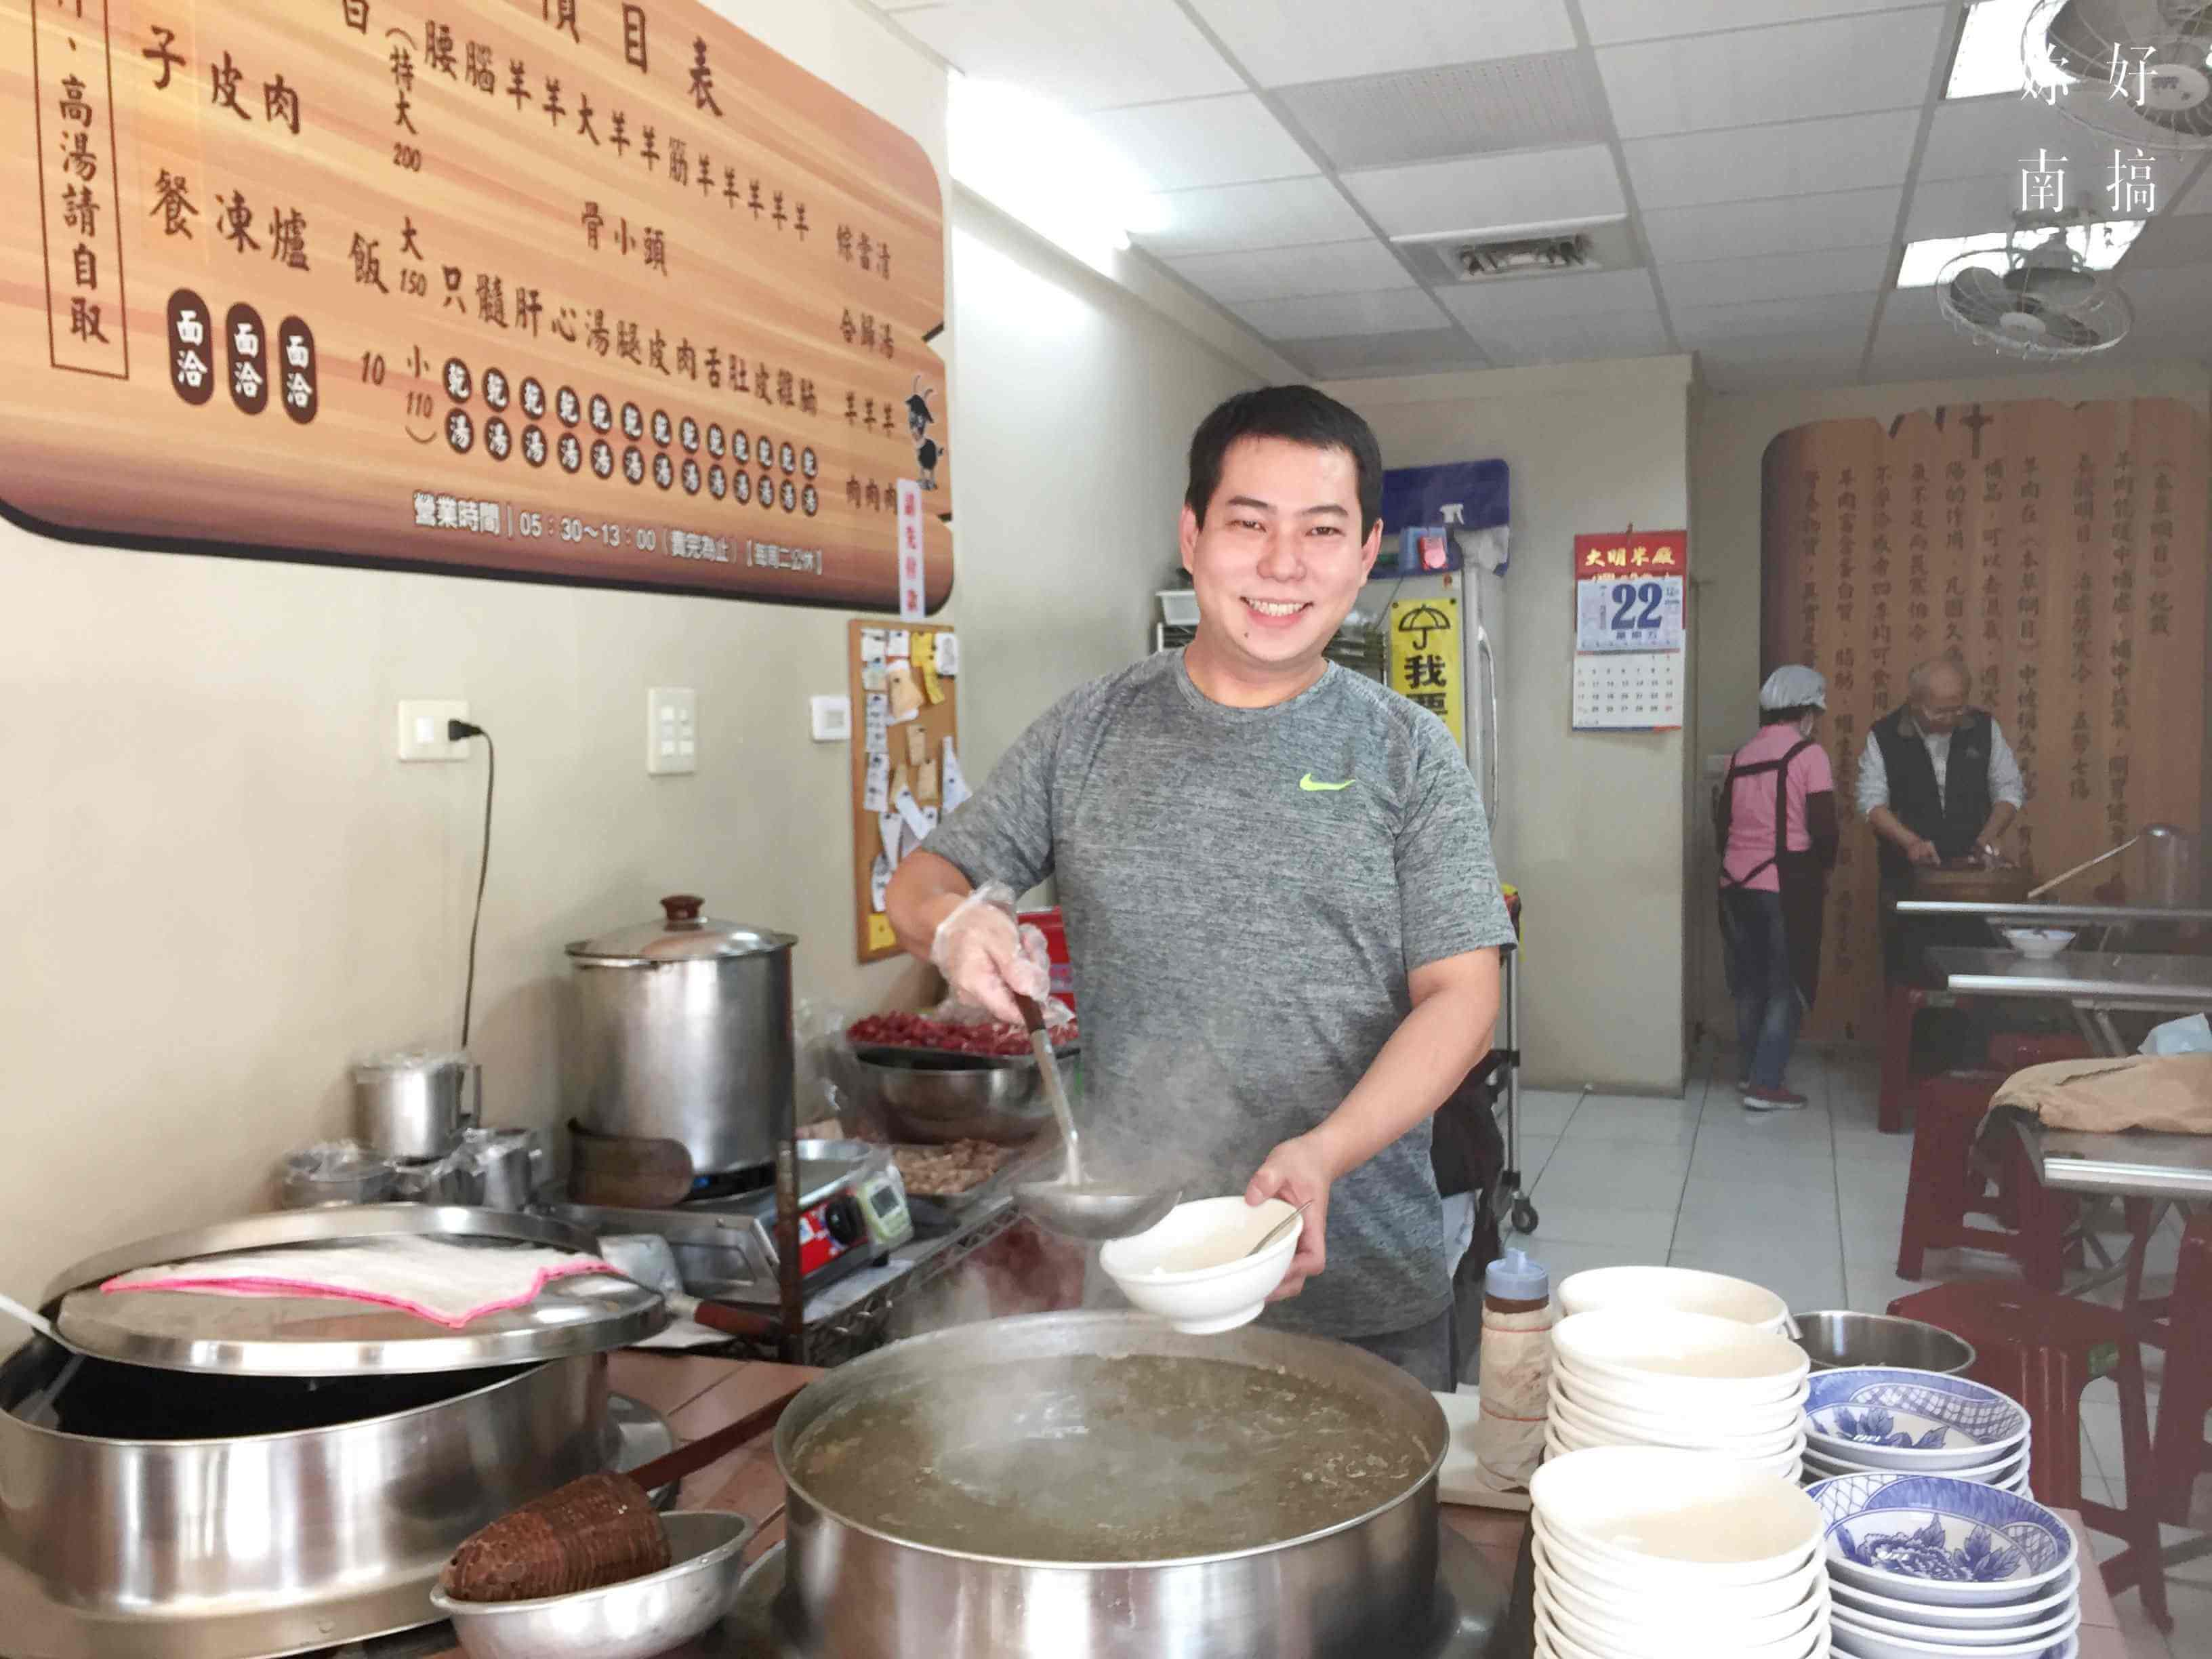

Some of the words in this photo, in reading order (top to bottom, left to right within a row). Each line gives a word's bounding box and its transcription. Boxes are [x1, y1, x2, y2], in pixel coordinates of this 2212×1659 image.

[57, 0, 110, 345] 、高湯請自取
[176, 310, 207, 388] 面洽
[233, 323, 264, 399] 面洽
[285, 335, 314, 409] 面洽
[361, 351, 386, 386] 10
[414, 491, 500, 537] 營業時間
[1612, 583, 1662, 630] 22
